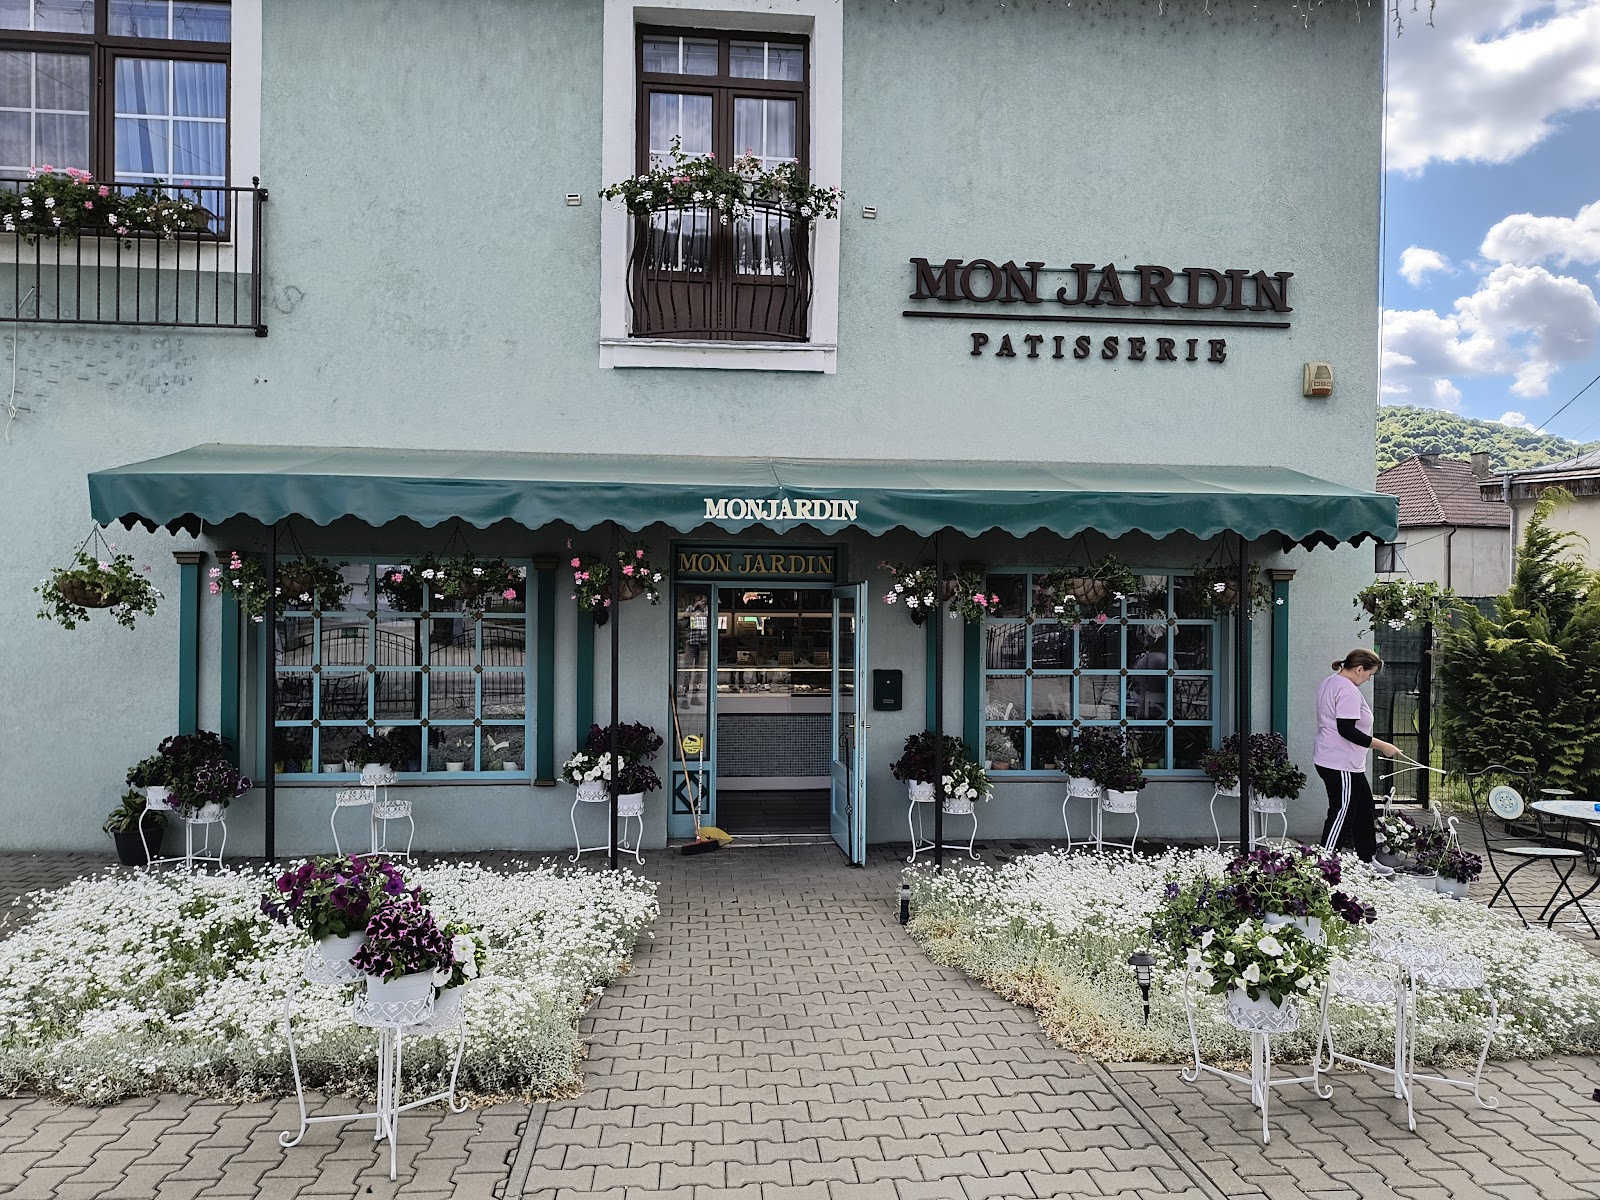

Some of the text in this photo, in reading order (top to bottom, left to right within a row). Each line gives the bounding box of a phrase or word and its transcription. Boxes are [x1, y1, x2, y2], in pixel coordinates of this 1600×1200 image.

[910, 258, 1294, 312] MON JARDIN
[971, 332, 1228, 364] PATISSERIE
[678, 552, 834, 574] MON JARDIN
